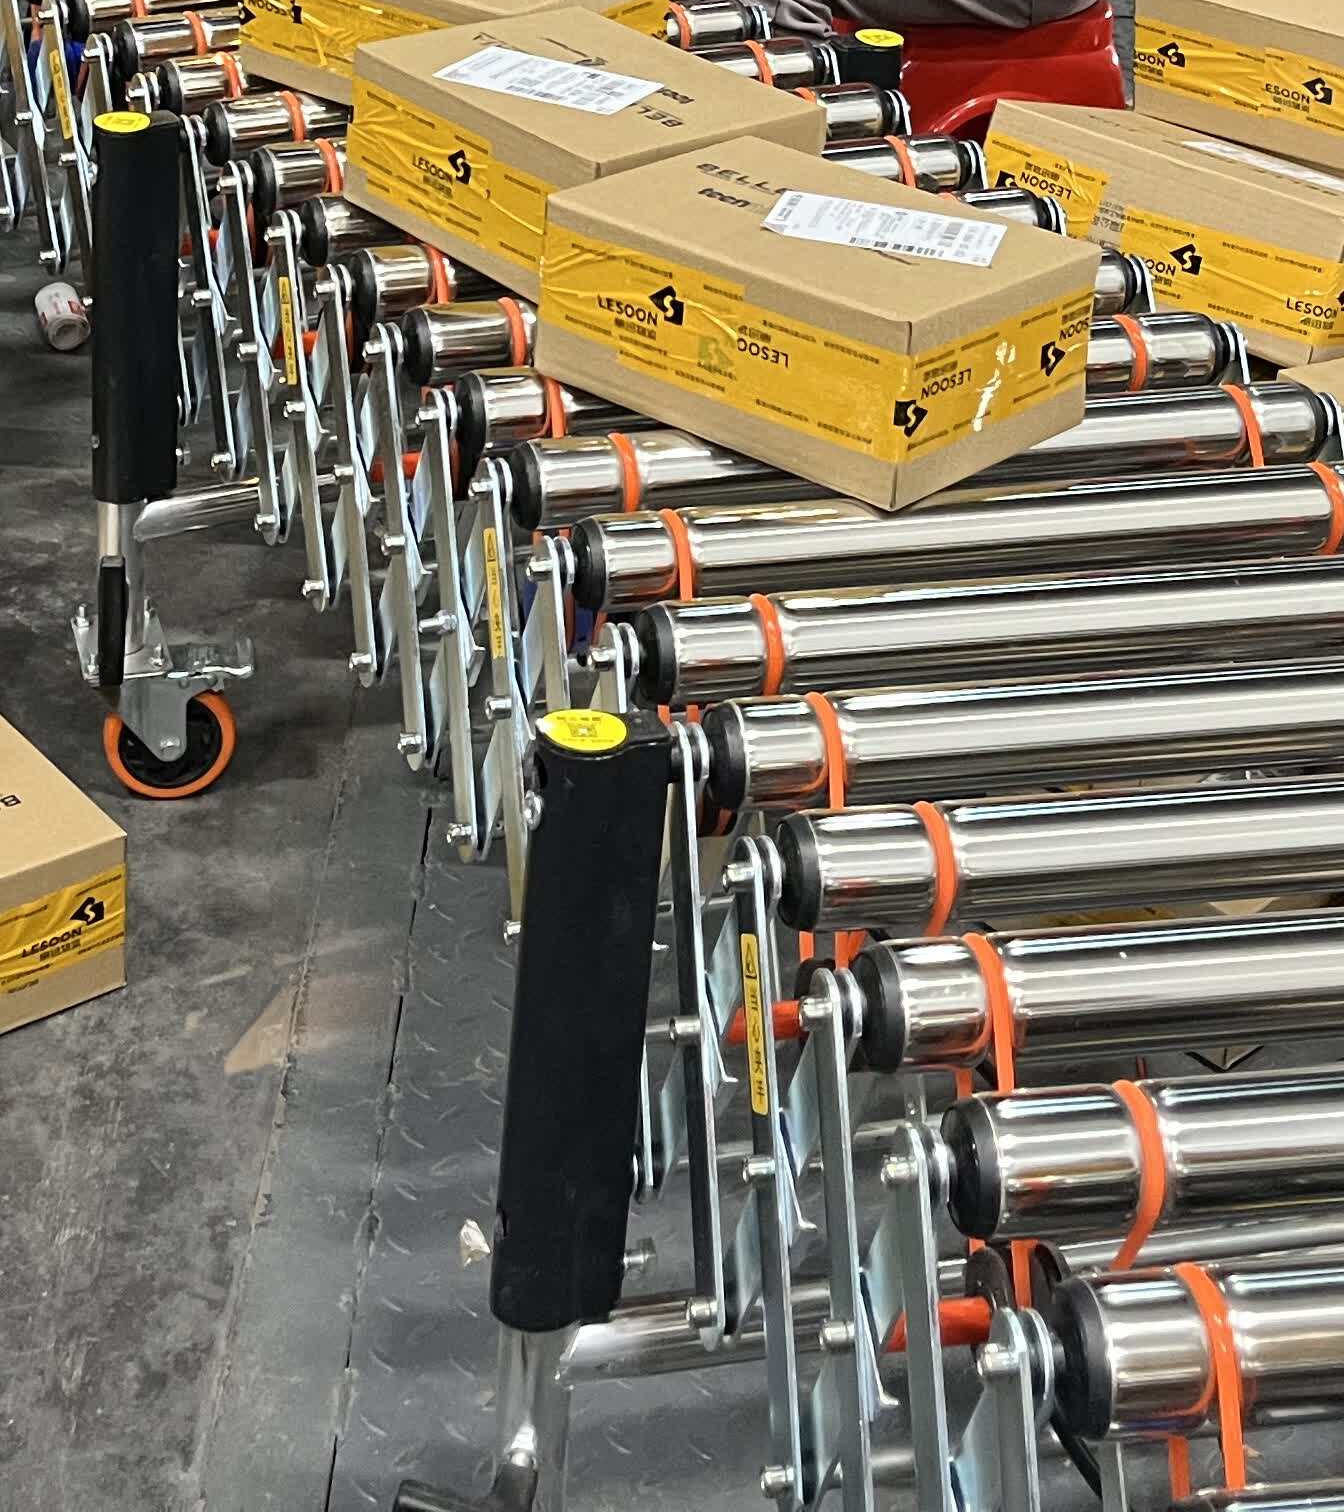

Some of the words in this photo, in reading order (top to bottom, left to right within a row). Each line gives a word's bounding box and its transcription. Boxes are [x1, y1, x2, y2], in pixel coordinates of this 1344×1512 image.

[1020, 171, 1073, 200] LESOON
[596, 294, 659, 328] LESOON
[921, 369, 973, 401] LESOON
[22, 927, 83, 959] LESOON
